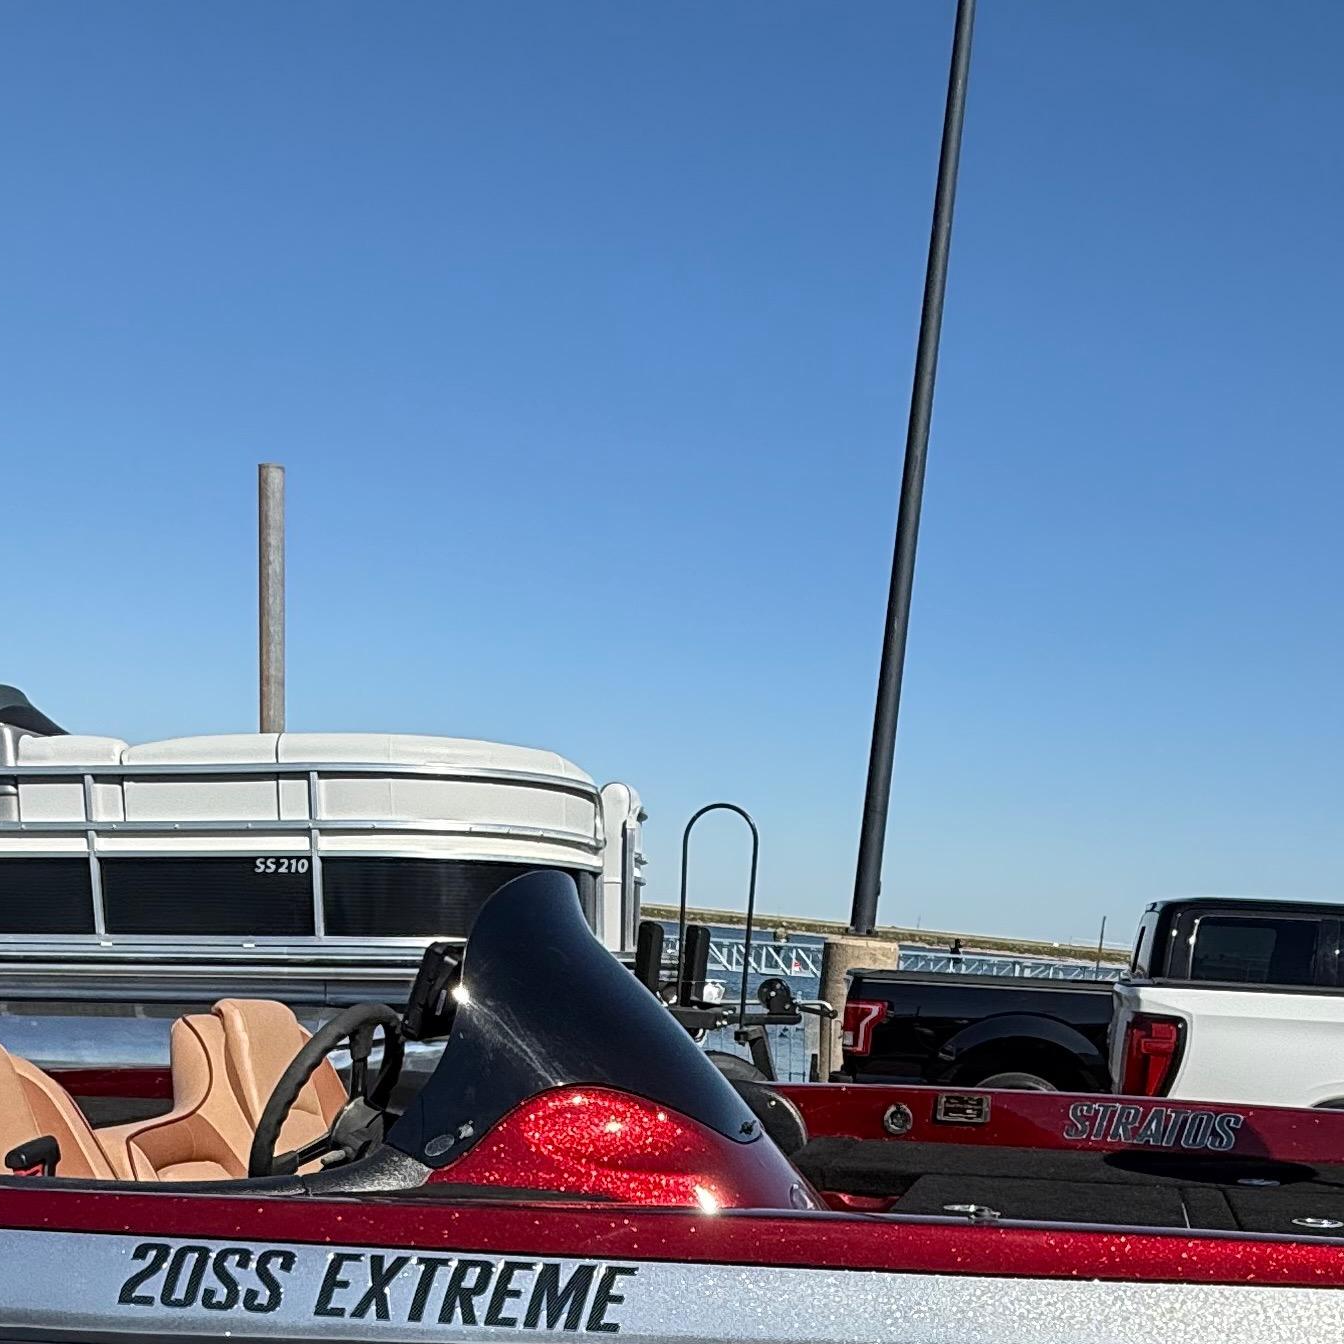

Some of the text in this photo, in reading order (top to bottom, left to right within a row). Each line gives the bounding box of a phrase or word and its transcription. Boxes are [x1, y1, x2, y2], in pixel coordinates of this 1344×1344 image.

[254, 858, 309, 873] SS 210
[1063, 1102, 1243, 1151] STRATOS
[118, 1242, 639, 1333] 20SS EXTREME
